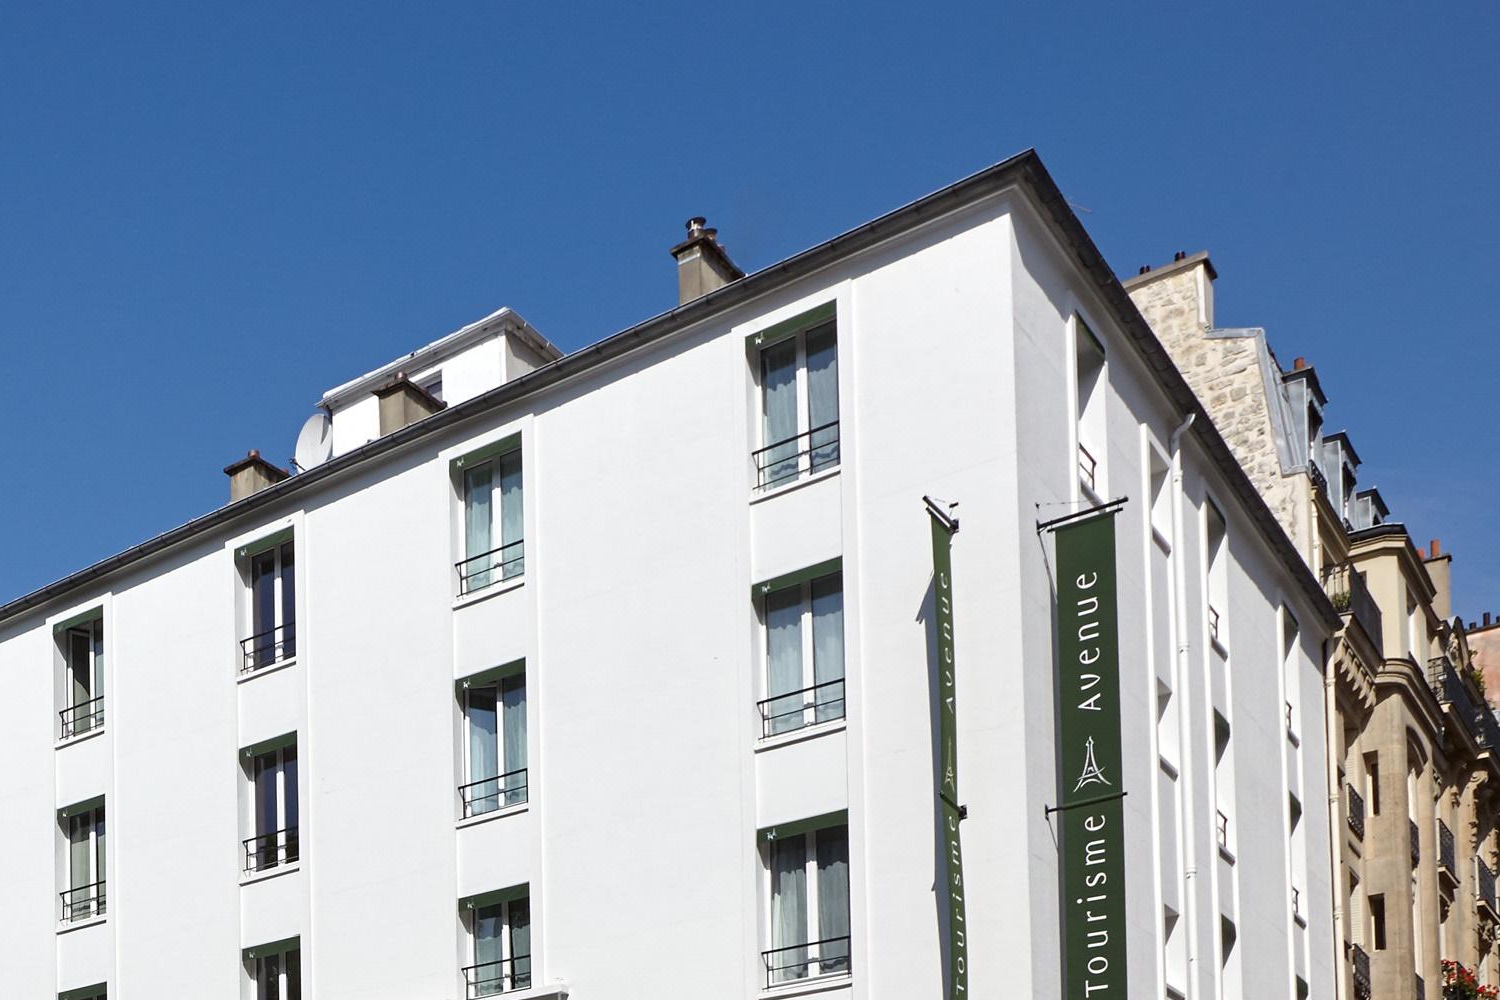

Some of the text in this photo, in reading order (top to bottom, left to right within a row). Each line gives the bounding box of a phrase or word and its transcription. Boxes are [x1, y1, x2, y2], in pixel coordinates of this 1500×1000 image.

[1076, 571, 1102, 711] Avenue
[948, 816, 965, 996] Tourisme
[1076, 814, 1109, 999] Tourisme
